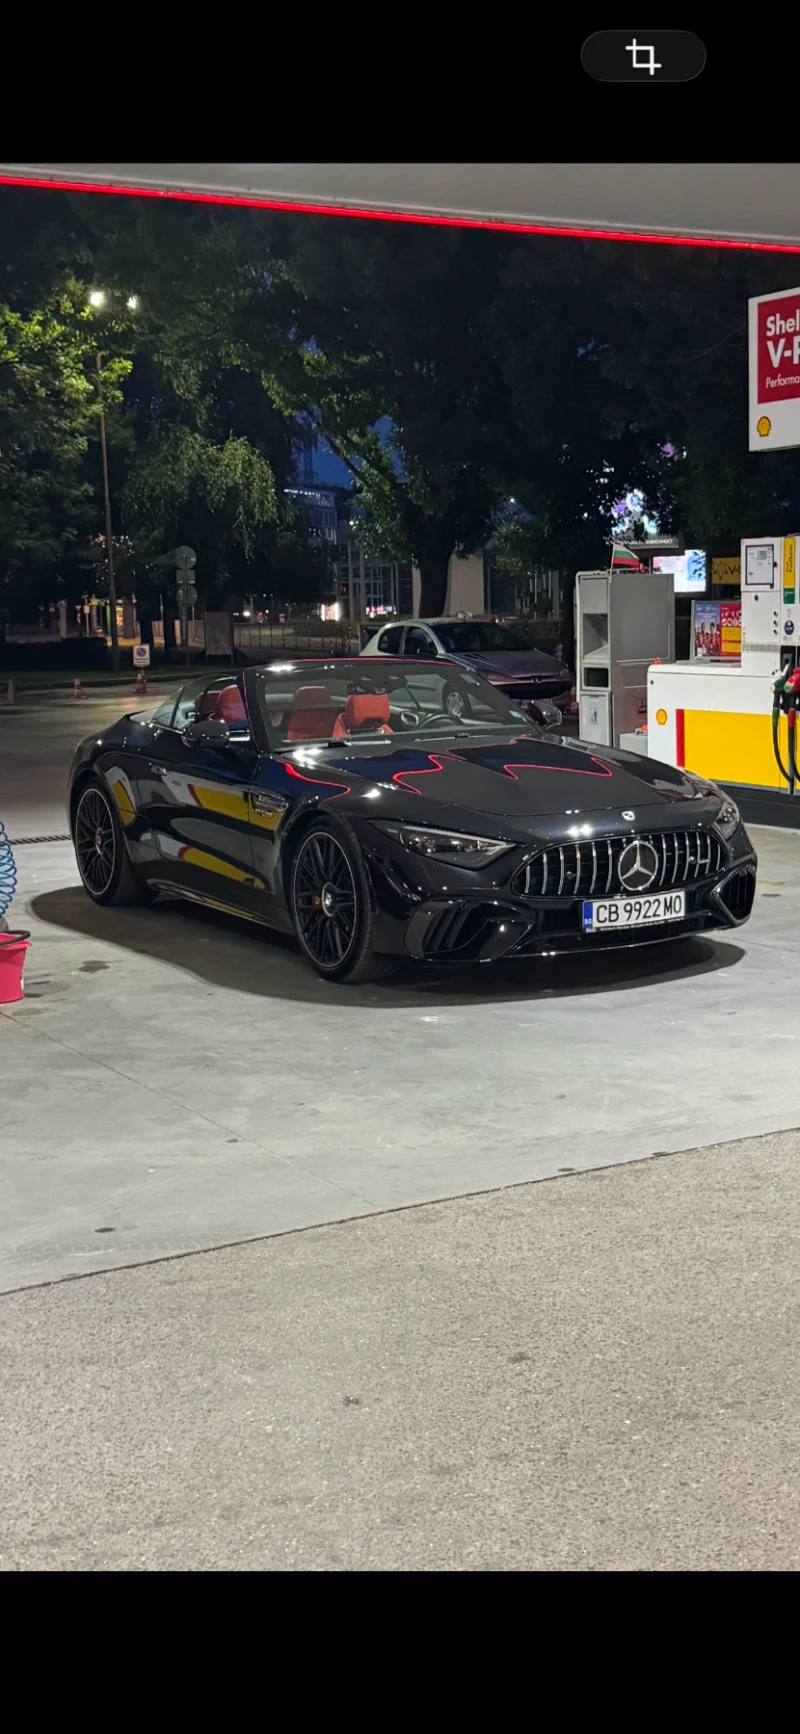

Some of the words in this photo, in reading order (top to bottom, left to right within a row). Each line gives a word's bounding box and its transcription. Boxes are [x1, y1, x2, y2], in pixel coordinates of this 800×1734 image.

[596, 903, 620, 924] CB
[623, 898, 661, 921] 9922
[663, 895, 682, 916] MO
